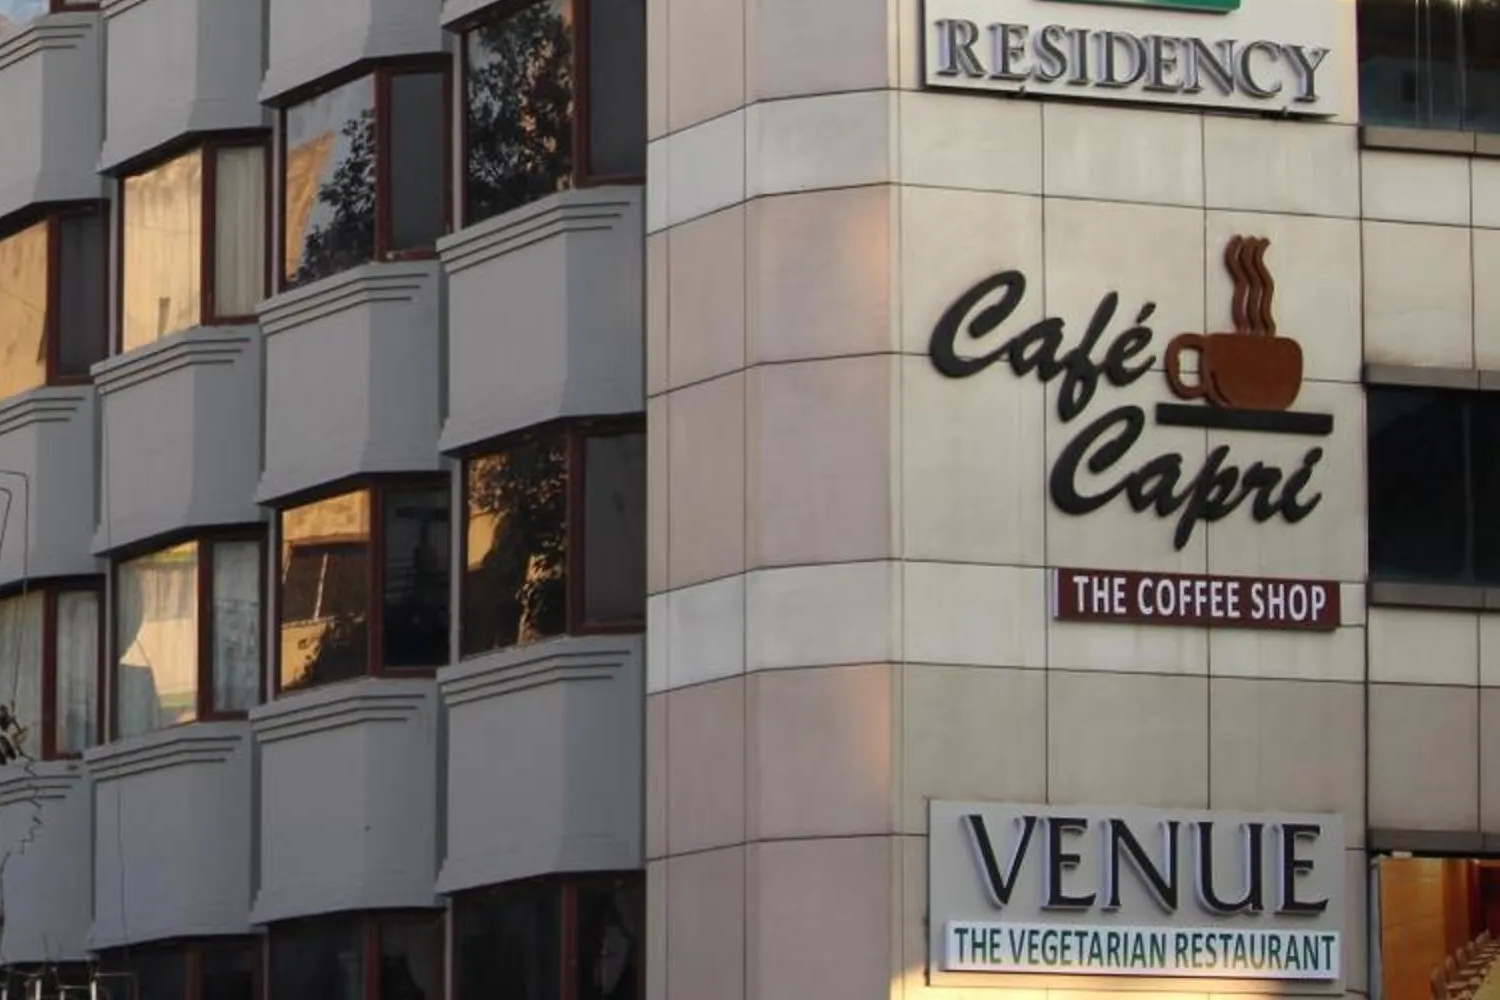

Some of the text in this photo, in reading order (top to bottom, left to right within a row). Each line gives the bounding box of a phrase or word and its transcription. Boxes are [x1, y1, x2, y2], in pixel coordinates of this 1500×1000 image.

[934, 18, 1331, 102] RESIDENCY
[929, 270, 1156, 423] Café
[1049, 404, 1324, 550] Capri
[1073, 575, 1327, 621] THE COFFEE SHOP
[960, 813, 1329, 916] VENUE
[953, 926, 1336, 971] THE VEGETARIAN RESTAURANT
